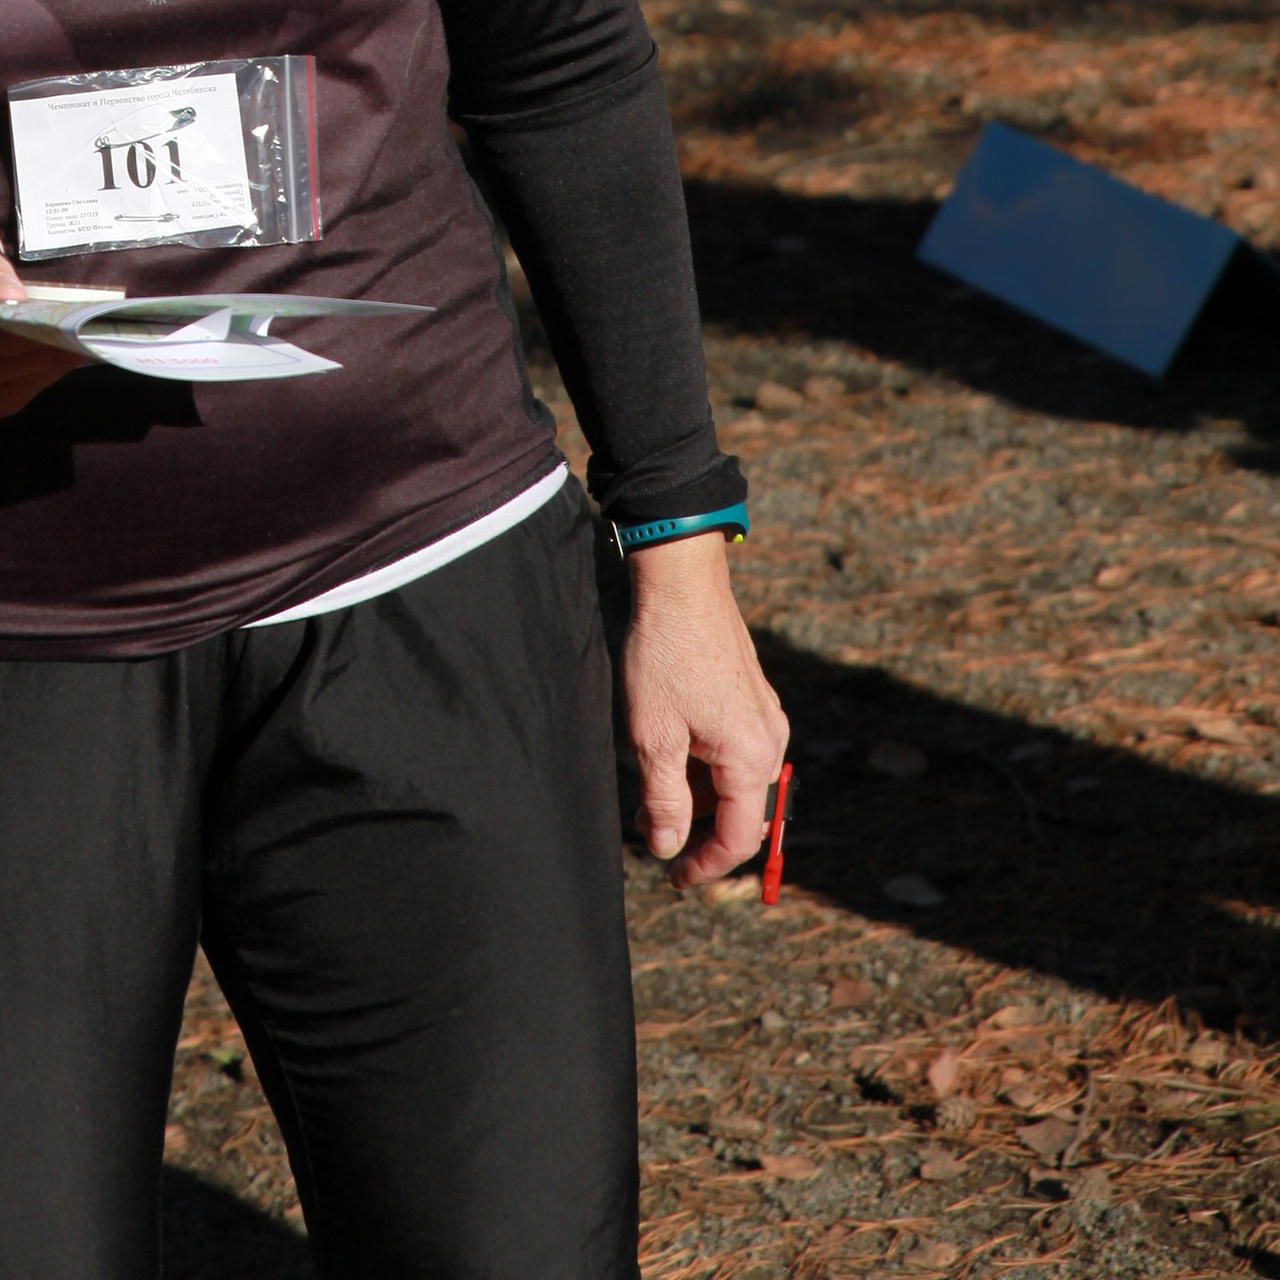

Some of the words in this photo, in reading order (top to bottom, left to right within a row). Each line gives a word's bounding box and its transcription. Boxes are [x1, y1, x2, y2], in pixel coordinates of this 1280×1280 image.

[47, 101, 90, 110] Чемпионат
[99, 95, 145, 106] Первенство
[171, 85, 217, 96] Челябинска
[94, 137, 187, 191] 101
